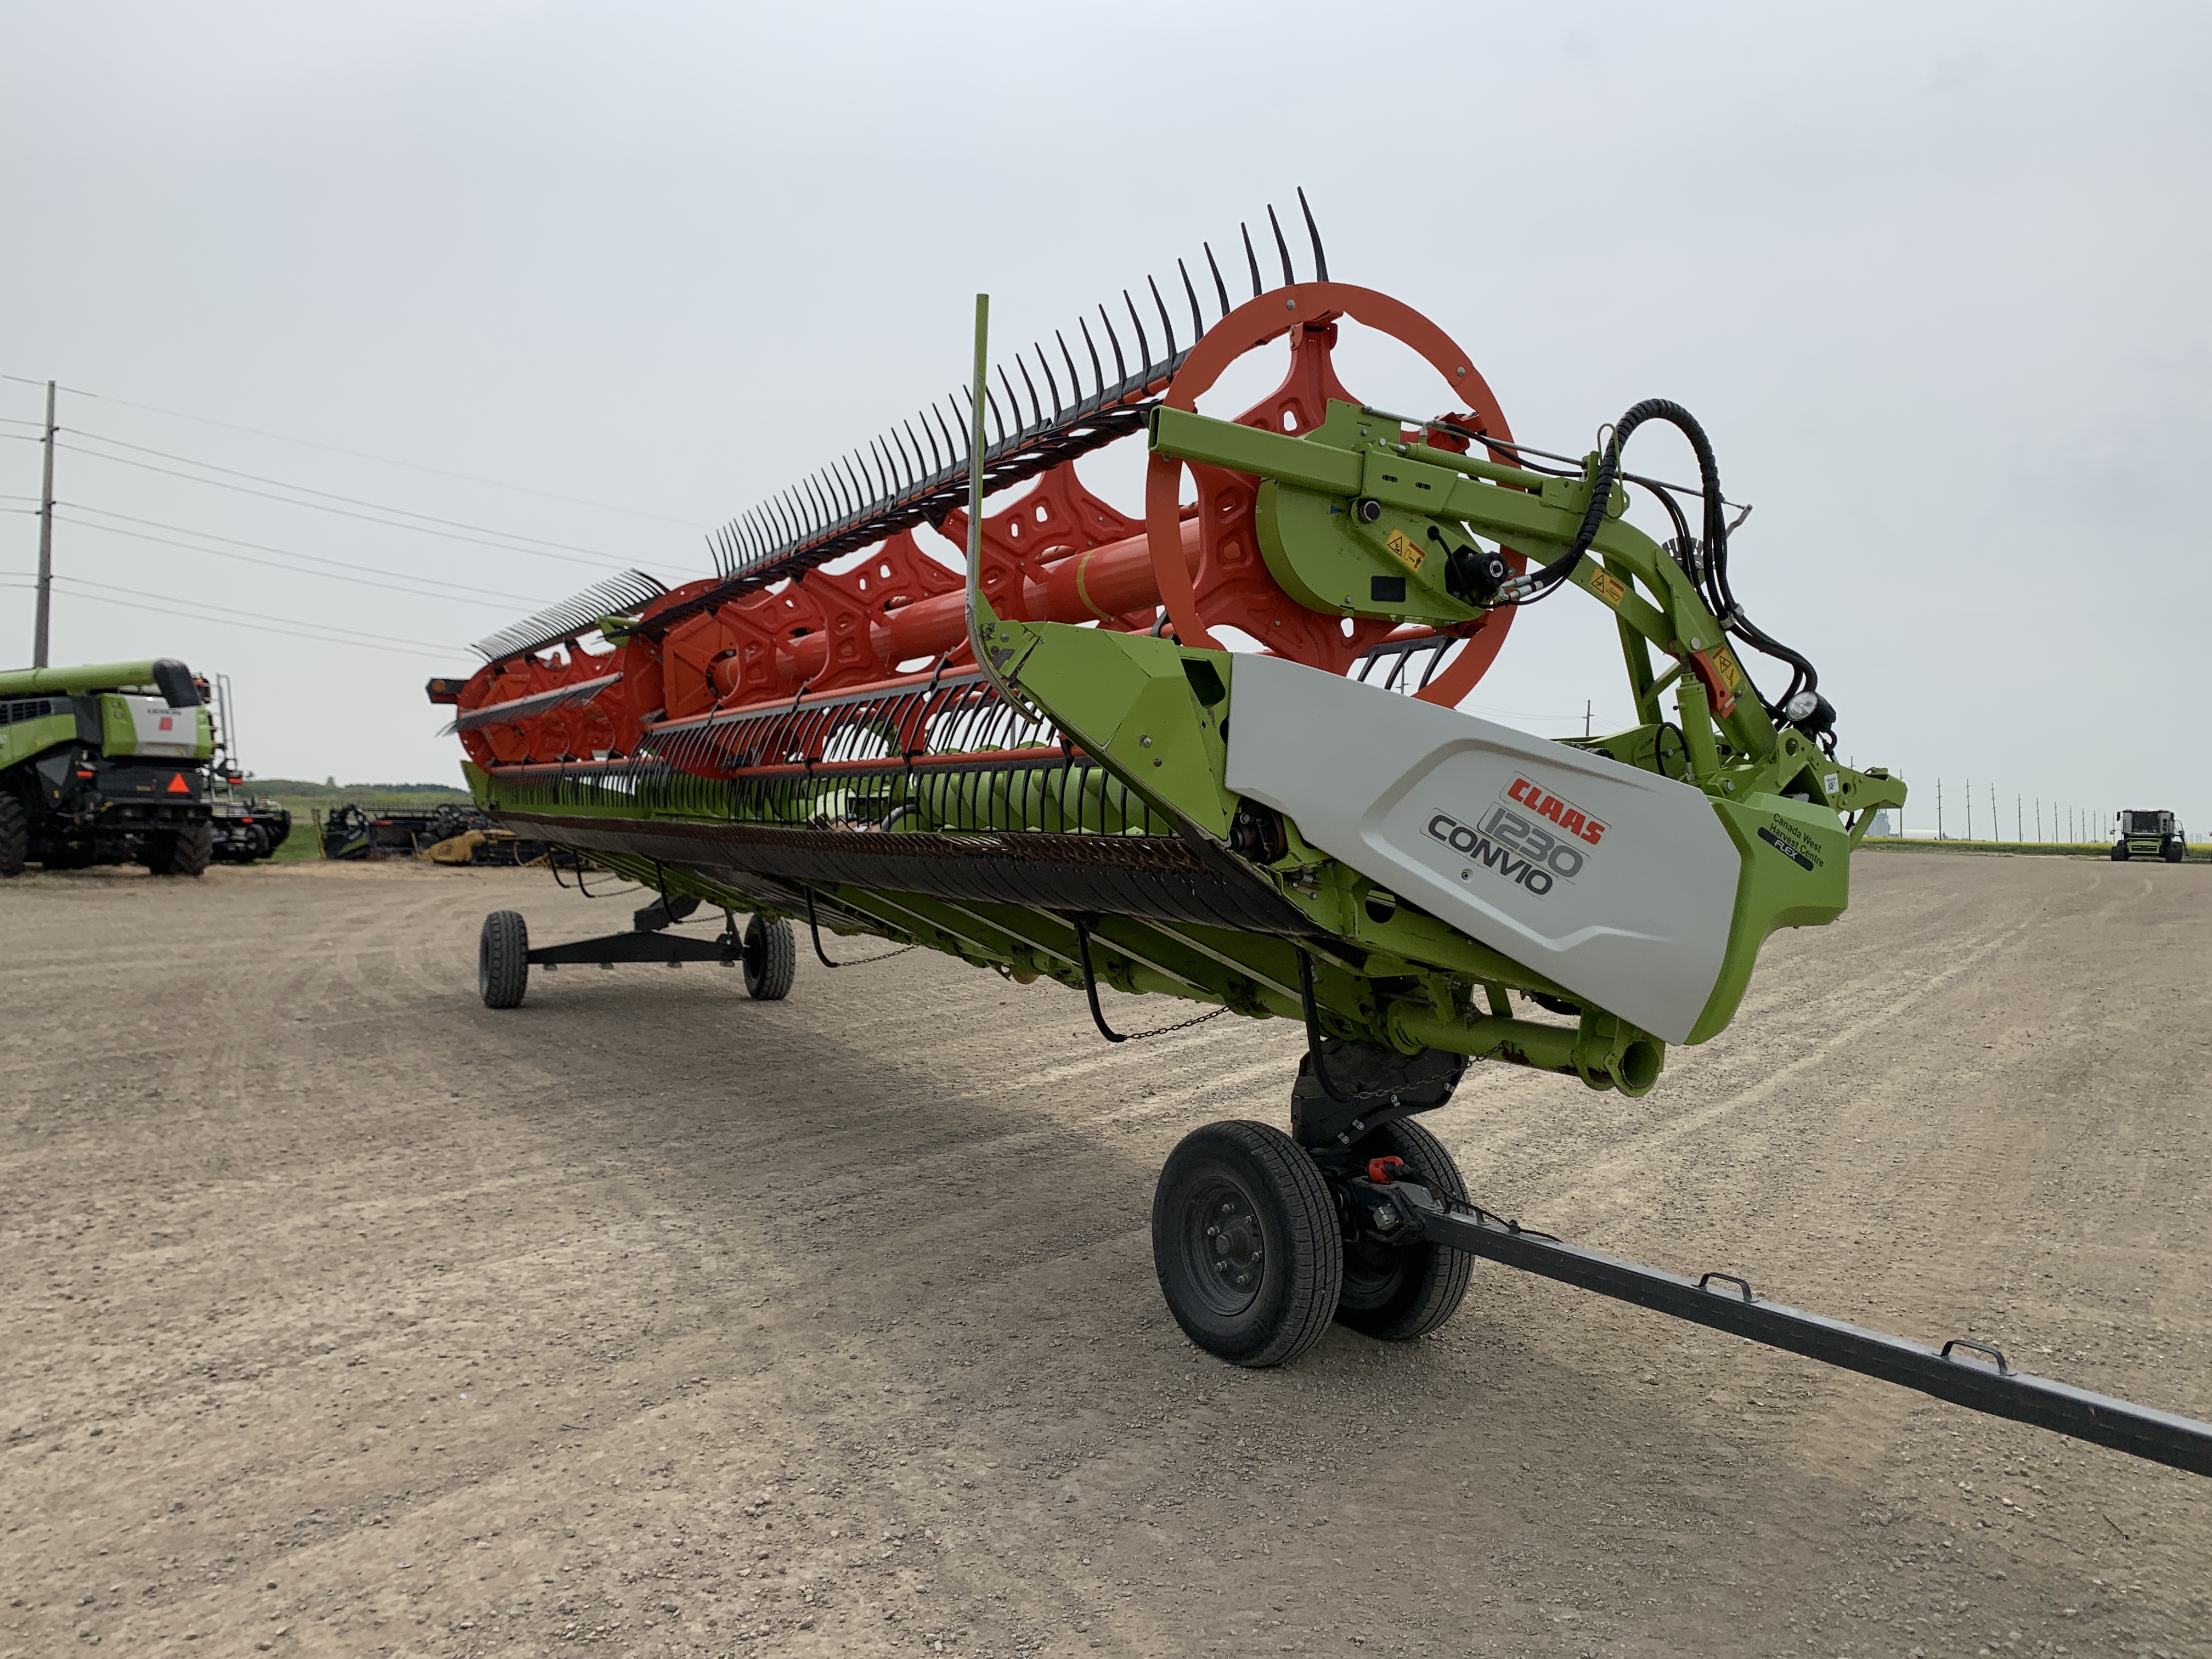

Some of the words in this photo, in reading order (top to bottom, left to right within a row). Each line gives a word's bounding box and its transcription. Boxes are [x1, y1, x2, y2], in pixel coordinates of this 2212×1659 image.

[1508, 777, 1605, 845] CLAAS
[1774, 814, 1801, 838] Canada
[1803, 833, 1821, 853] West
[1428, 815, 1553, 895] CONVIO
[1485, 808, 1583, 878] 1230
[1770, 823, 1798, 849] Harvest
[1801, 846, 1824, 867] Centre
[1775, 840, 1798, 860] FLEX
